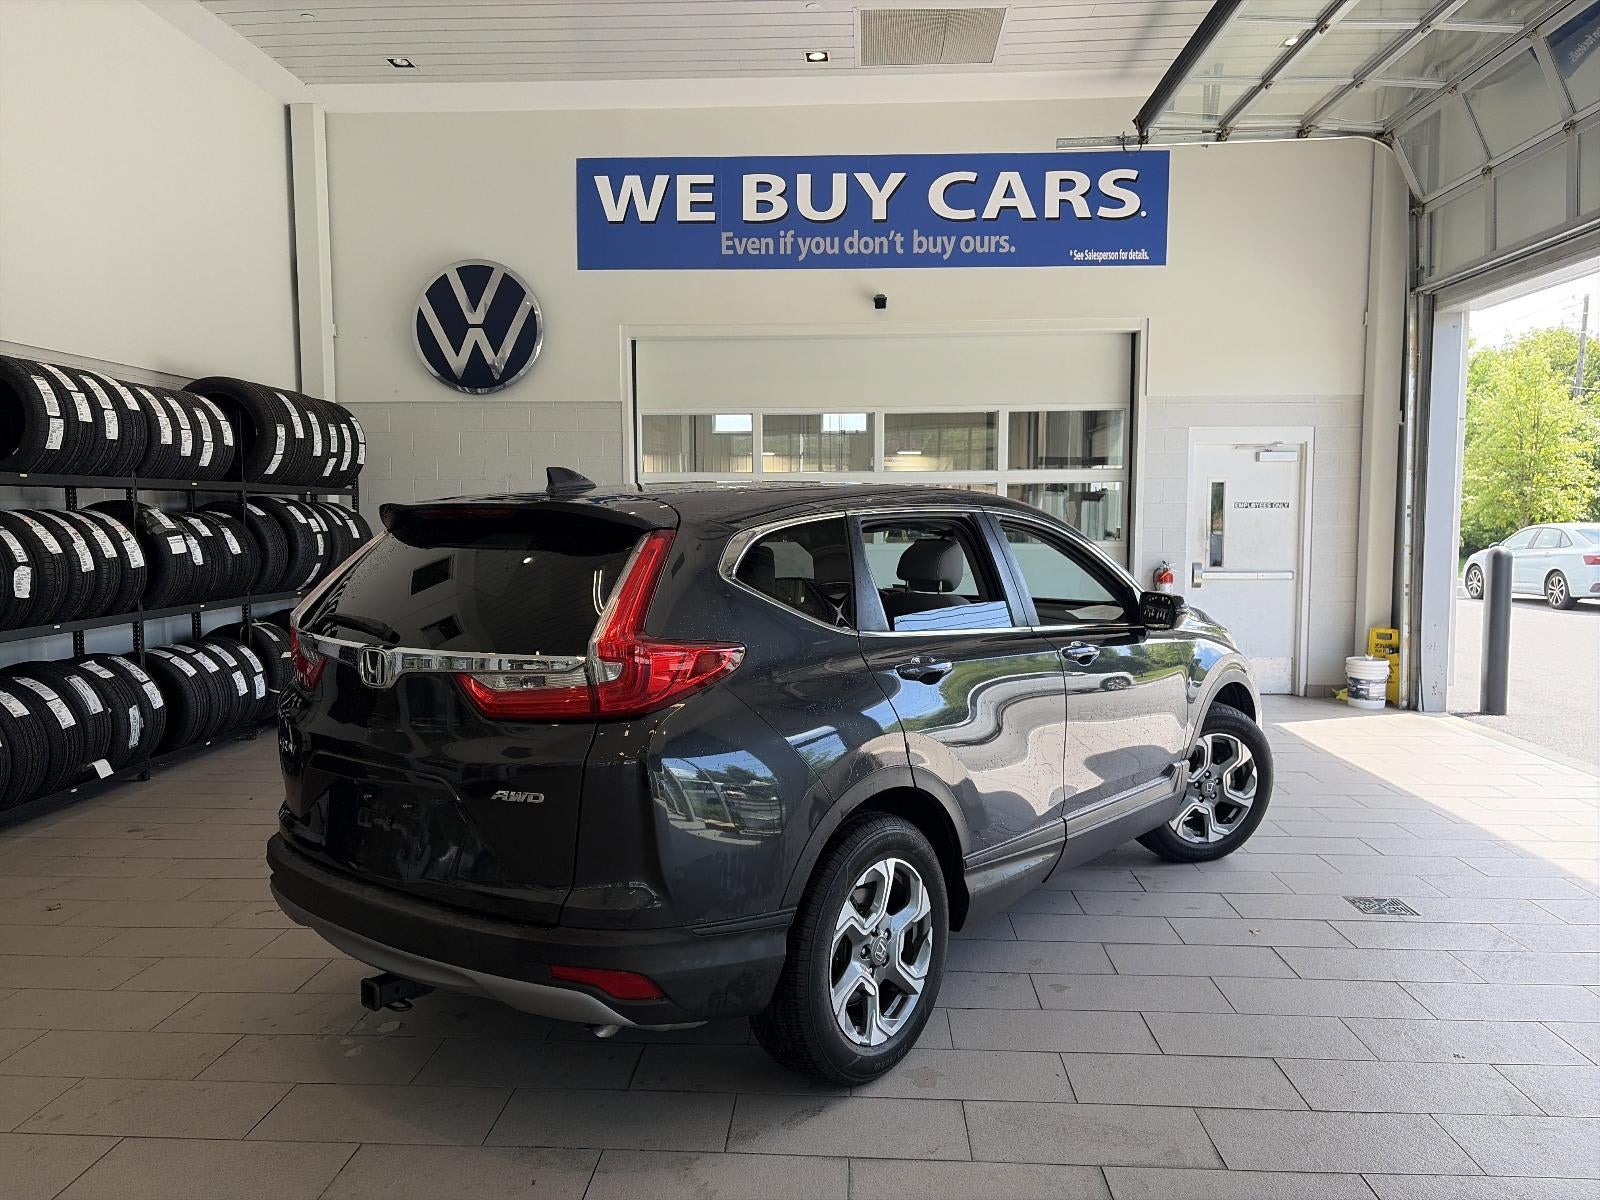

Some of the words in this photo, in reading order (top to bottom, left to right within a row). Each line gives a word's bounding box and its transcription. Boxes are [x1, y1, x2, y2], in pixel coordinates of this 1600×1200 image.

[594, 174, 717, 223] WE
[742, 172, 908, 223] BUY
[927, 169, 1148, 220] CARS.
[720, 231, 774, 254] Even
[779, 230, 795, 255] if
[798, 235, 840, 262] you
[844, 229, 905, 255] don't
[912, 229, 957, 261] buy
[959, 234, 1016, 254] ours.
[1084, 248, 1118, 263] Salesperson
[1119, 248, 1128, 260] for
[1128, 248, 1150, 260] details.
[490, 790, 545, 804] AWD
